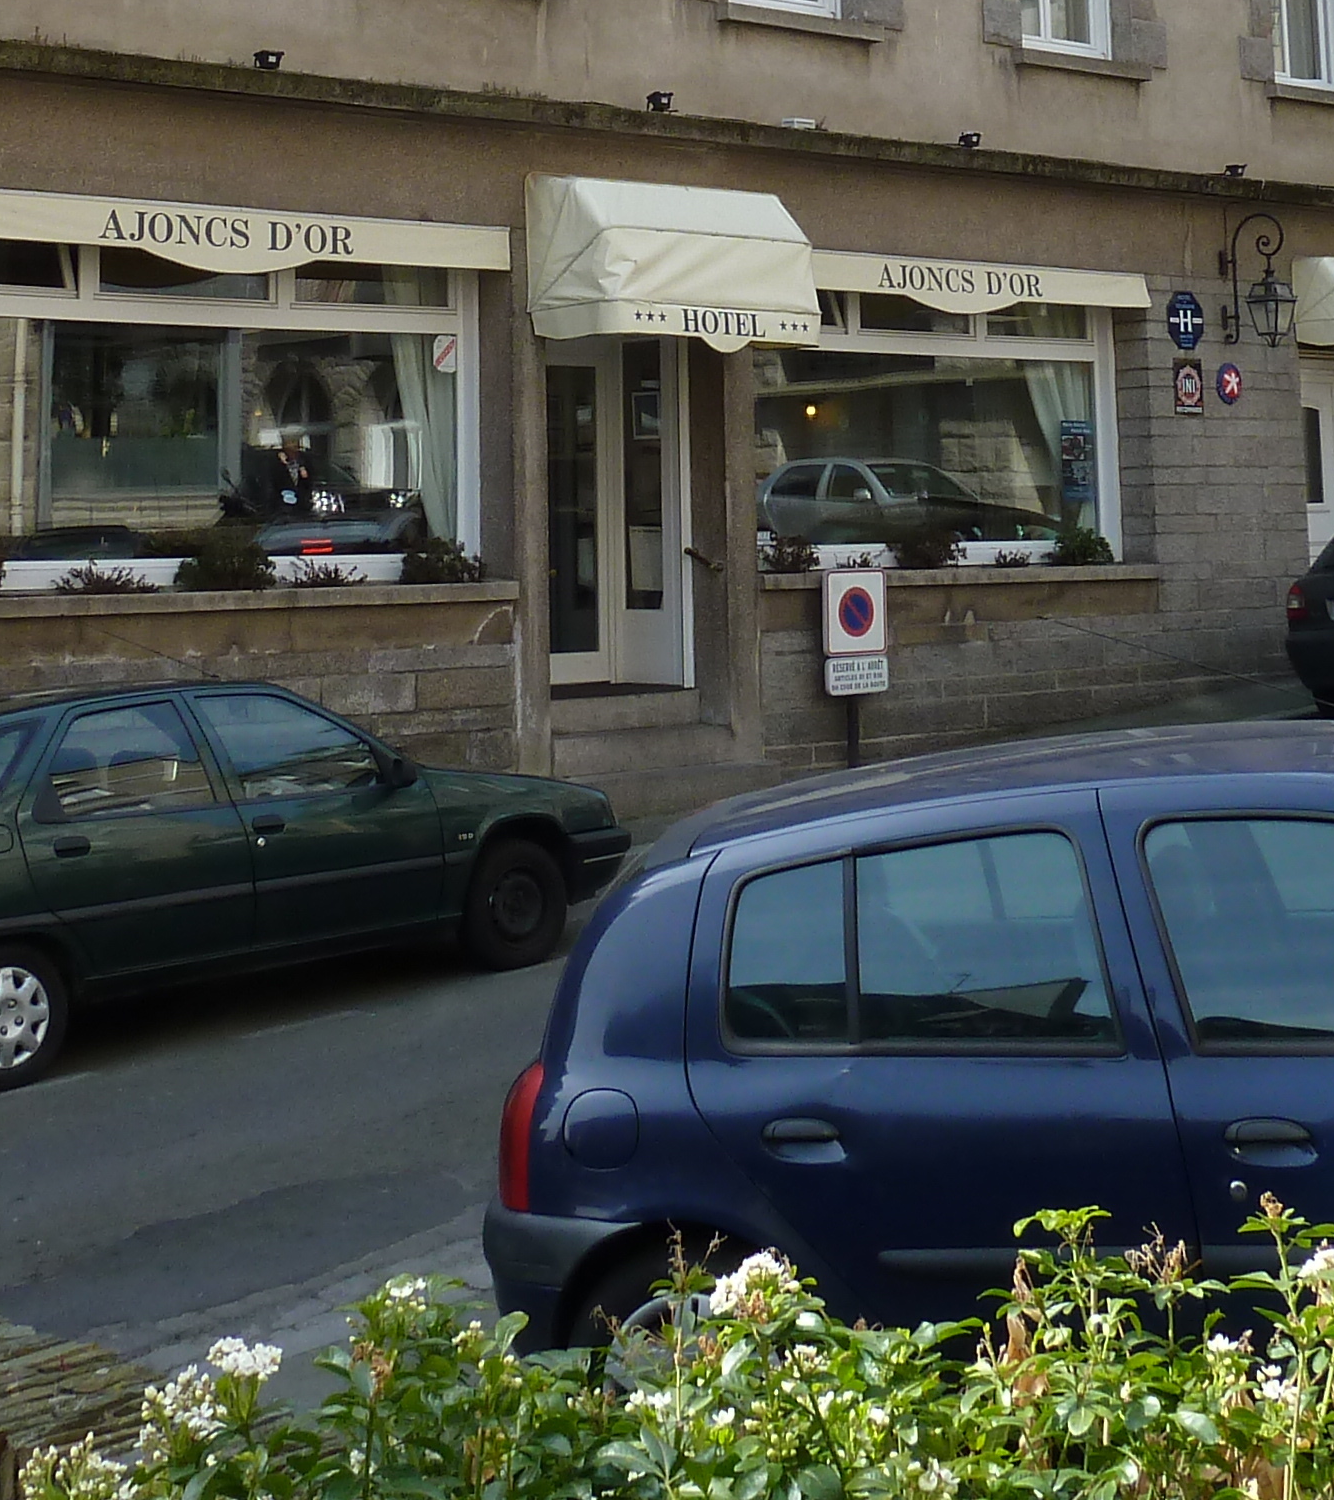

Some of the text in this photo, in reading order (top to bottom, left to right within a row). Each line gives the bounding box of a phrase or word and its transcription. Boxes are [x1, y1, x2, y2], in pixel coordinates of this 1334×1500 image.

[98, 209, 354, 255] AJONCS D'OR
[878, 263, 1043, 297] AJONCS D'OR
[681, 308, 766, 338] HOTEL
[1179, 310, 1192, 332] H
